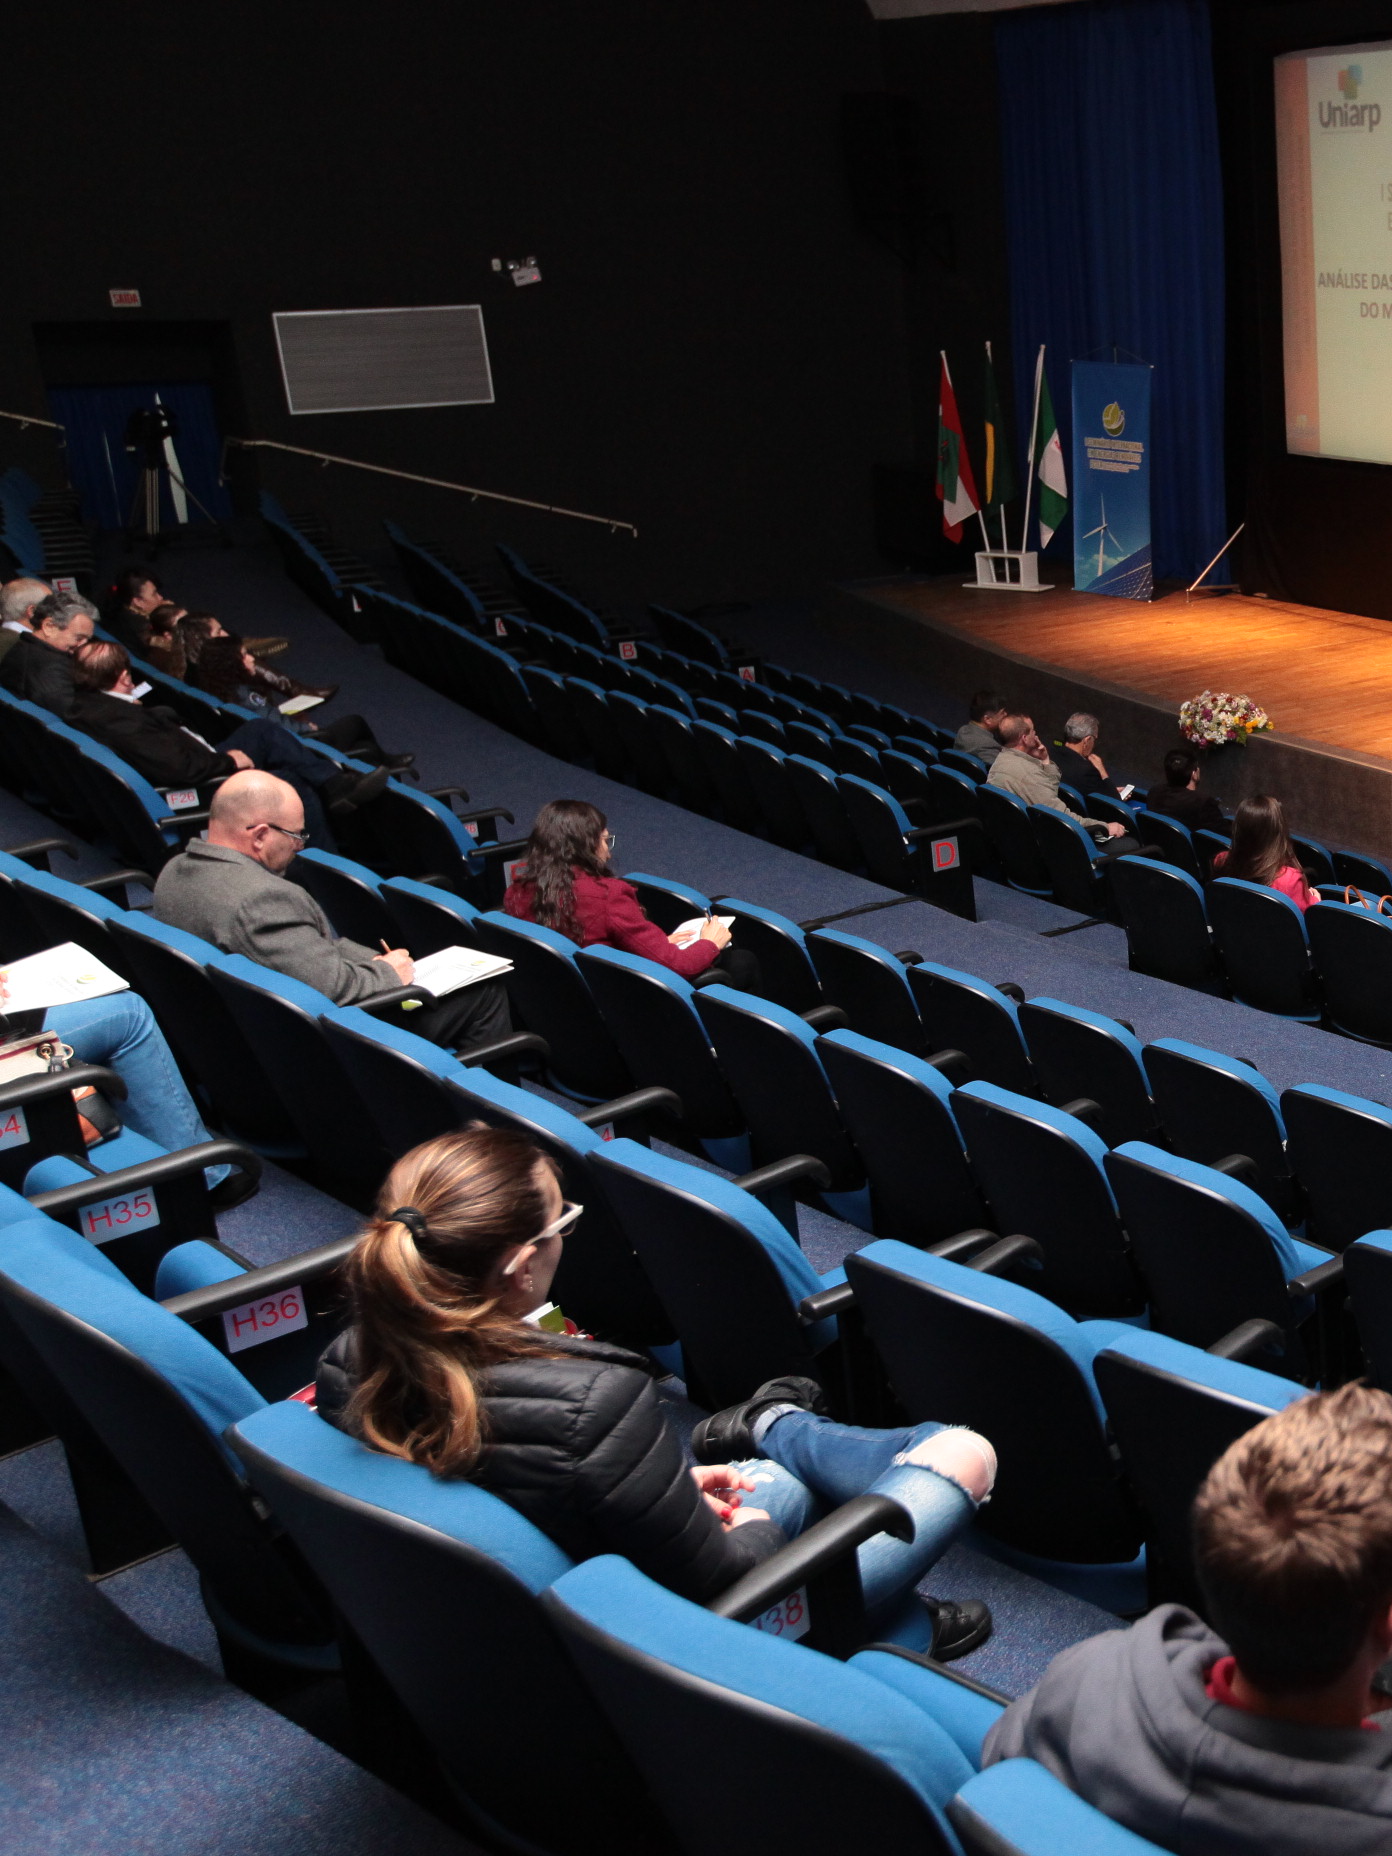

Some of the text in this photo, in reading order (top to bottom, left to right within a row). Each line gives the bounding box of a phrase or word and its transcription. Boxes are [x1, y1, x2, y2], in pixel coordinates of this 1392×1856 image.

[1318, 100, 1381, 133] Uniarp
[1318, 269, 1368, 290] ANÁLISE
[1360, 302, 1380, 319] DO
[622, 643, 635, 658] B
[743, 668, 754, 681] A
[170, 791, 196, 805] F26
[935, 842, 955, 868] D
[86, 1193, 153, 1233] H35
[231, 1293, 300, 1338] H36
[756, 1592, 804, 1636] 38
